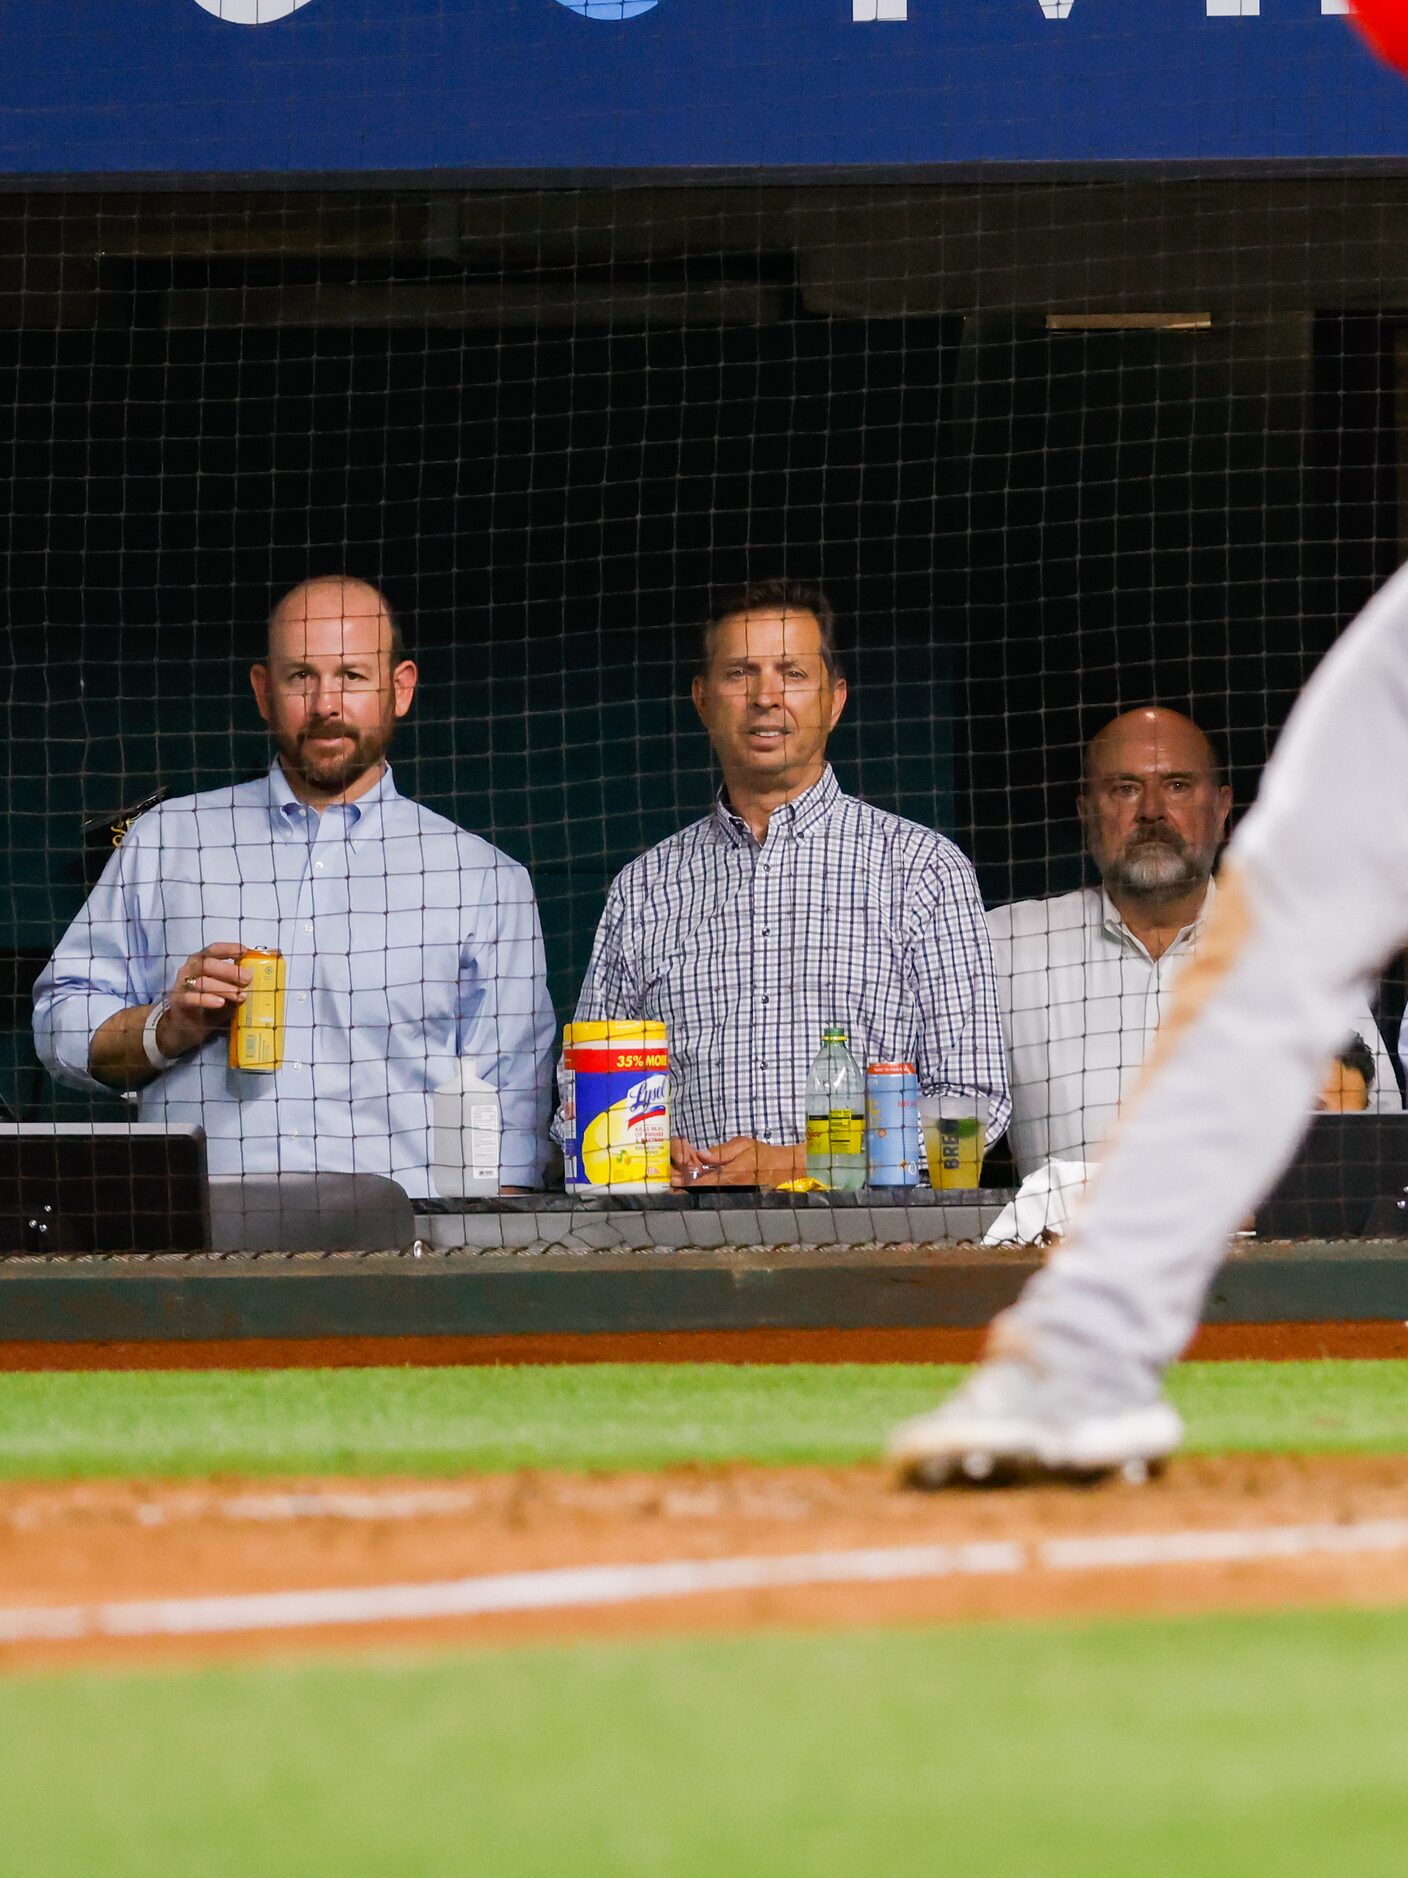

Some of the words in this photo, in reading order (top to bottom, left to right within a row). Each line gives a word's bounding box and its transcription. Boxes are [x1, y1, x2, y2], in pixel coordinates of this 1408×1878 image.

[617, 1055, 644, 1068] 35%
[629, 1077, 666, 1112] Lysol
[941, 1121, 959, 1169] BRE
